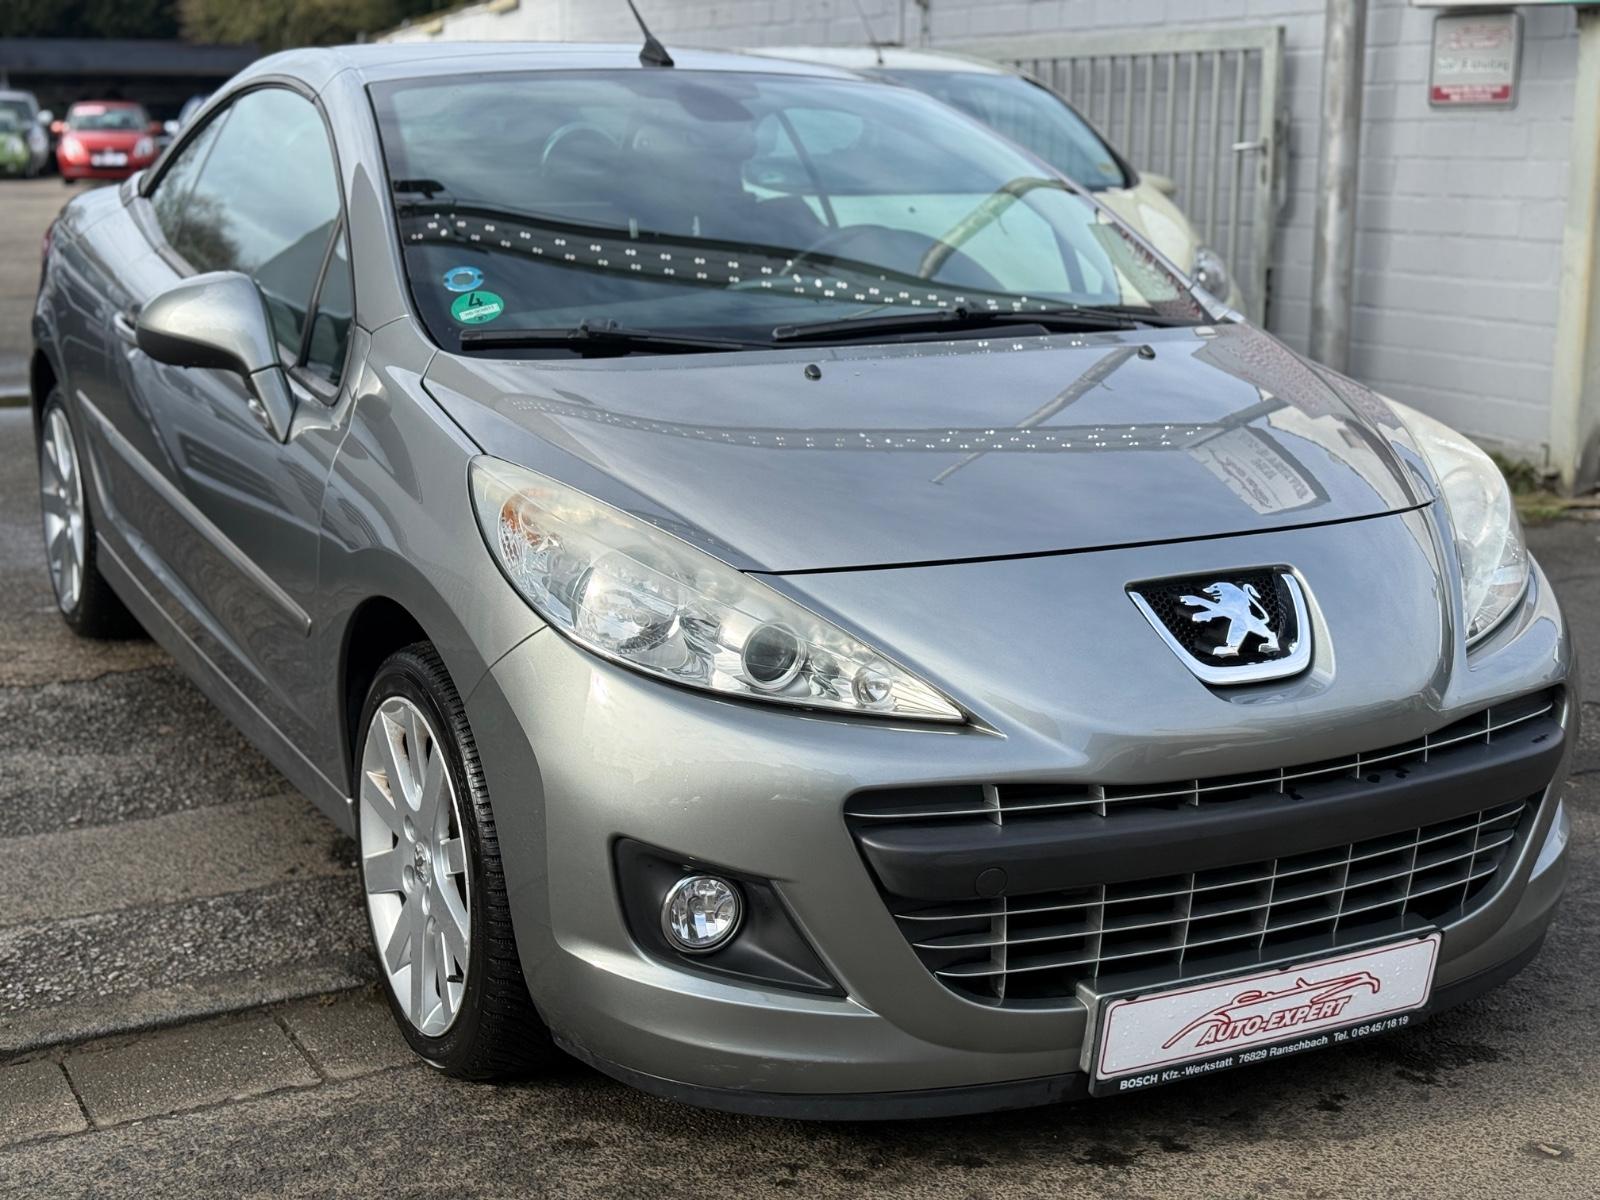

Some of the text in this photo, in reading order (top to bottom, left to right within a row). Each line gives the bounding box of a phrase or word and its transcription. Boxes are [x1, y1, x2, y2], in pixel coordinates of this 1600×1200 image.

[468, 292, 483, 308] 4
[1196, 995, 1352, 1047] AUTO-EXPERT
[1120, 1074, 1158, 1090] BOSCH
[1162, 1057, 1233, 1081] Kfz.-Werkstatt
[1238, 1049, 1267, 1064] 76829
[1269, 1036, 1328, 1057] Ranschbach
[1333, 1030, 1349, 1042] Tel.
